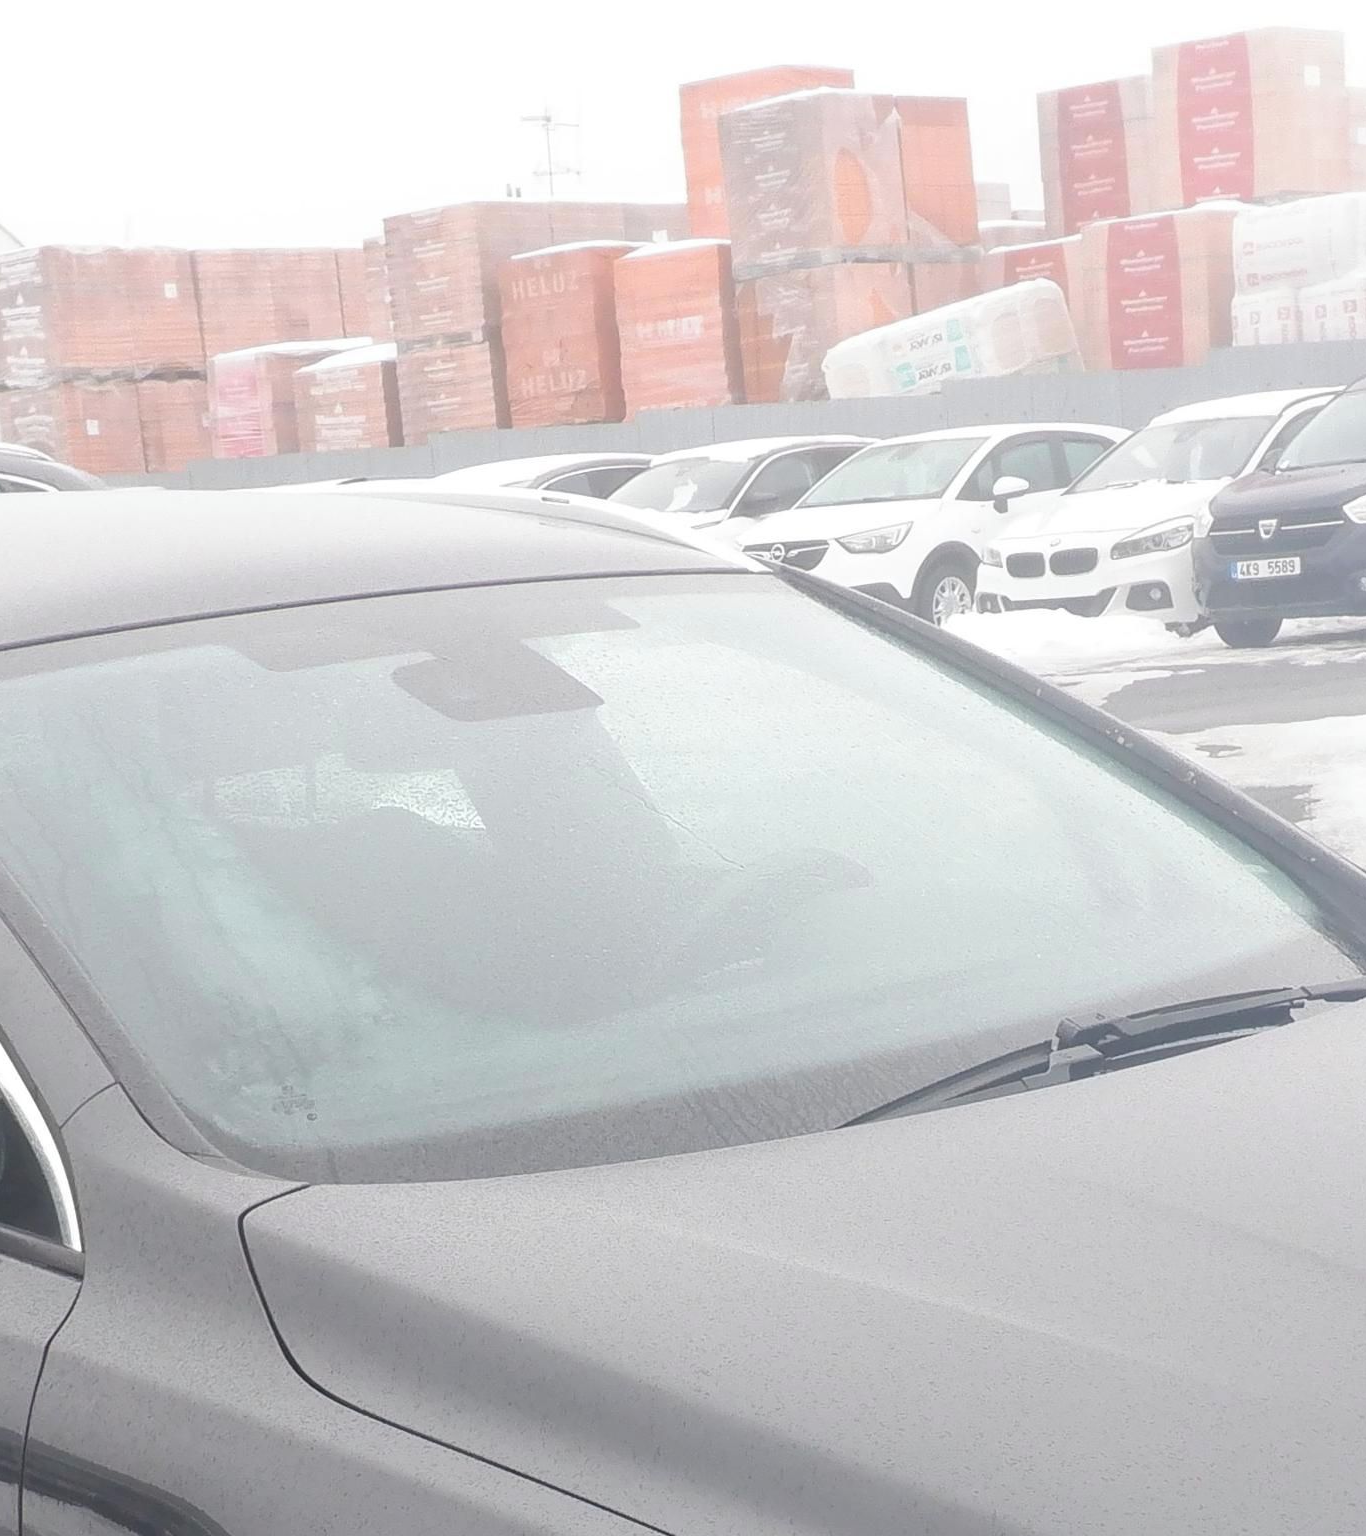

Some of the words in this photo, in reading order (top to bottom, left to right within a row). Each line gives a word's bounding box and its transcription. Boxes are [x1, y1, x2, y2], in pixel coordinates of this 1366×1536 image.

[511, 270, 579, 301] HELUZ
[521, 369, 588, 397] HELUZ
[1239, 563, 1259, 576] 4K9
[1268, 560, 1295, 574] 5589
